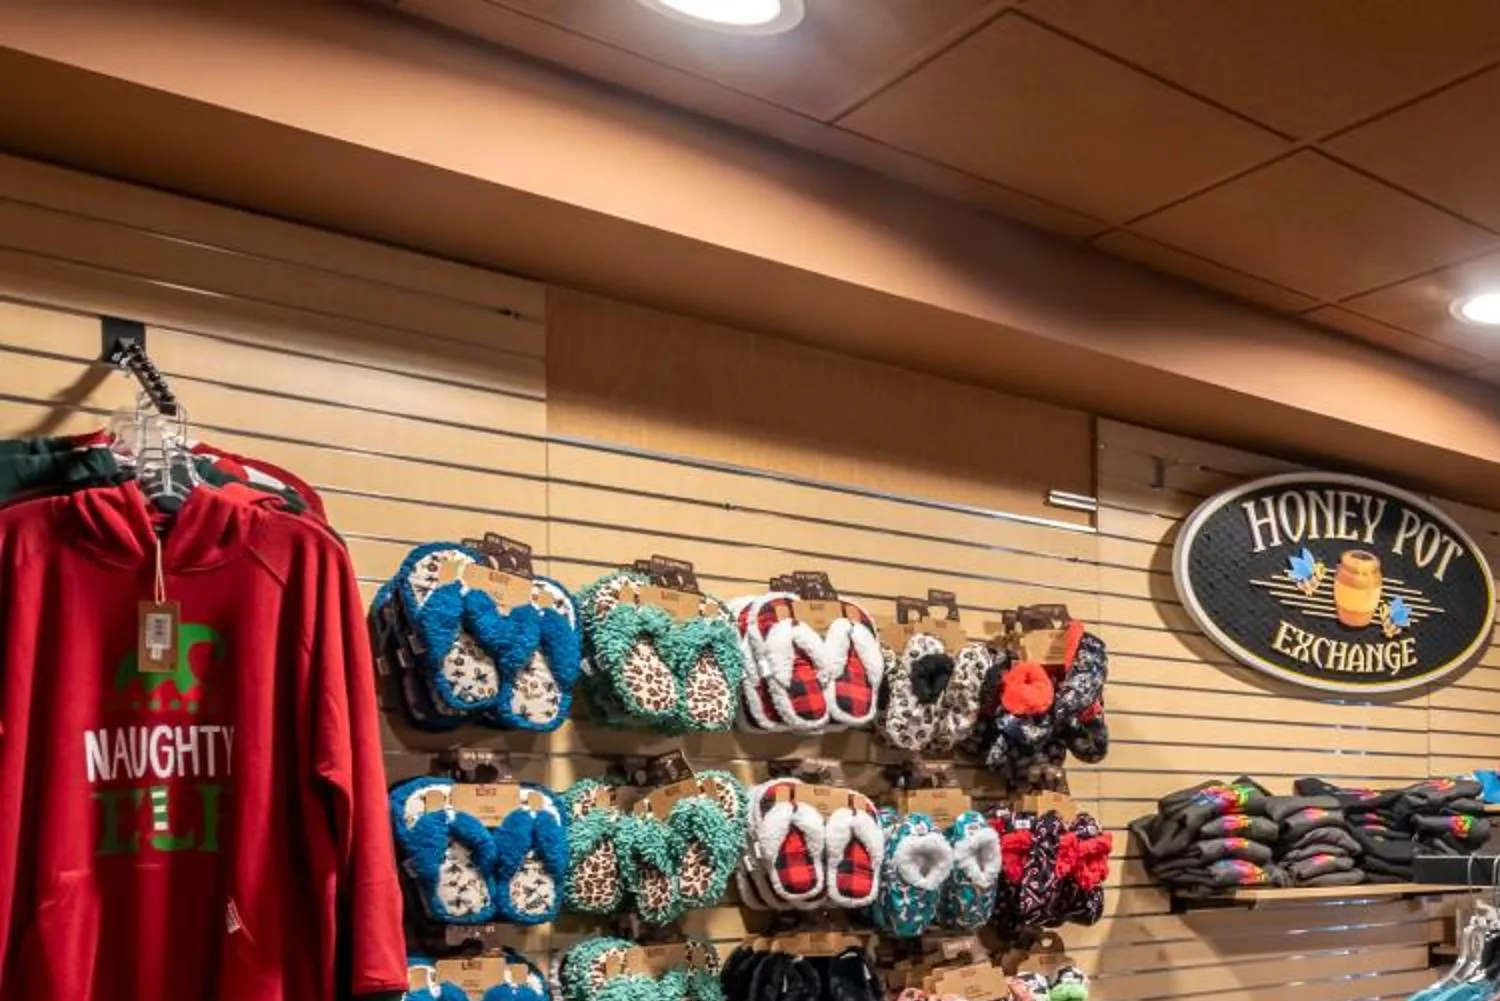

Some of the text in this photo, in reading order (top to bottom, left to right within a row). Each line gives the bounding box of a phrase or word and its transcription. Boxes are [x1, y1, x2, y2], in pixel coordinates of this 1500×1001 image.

[1241, 489, 1464, 582] HONEY POT
[1271, 619, 1418, 676] EXCHANGE
[83, 724, 235, 782] NAUGHTY
